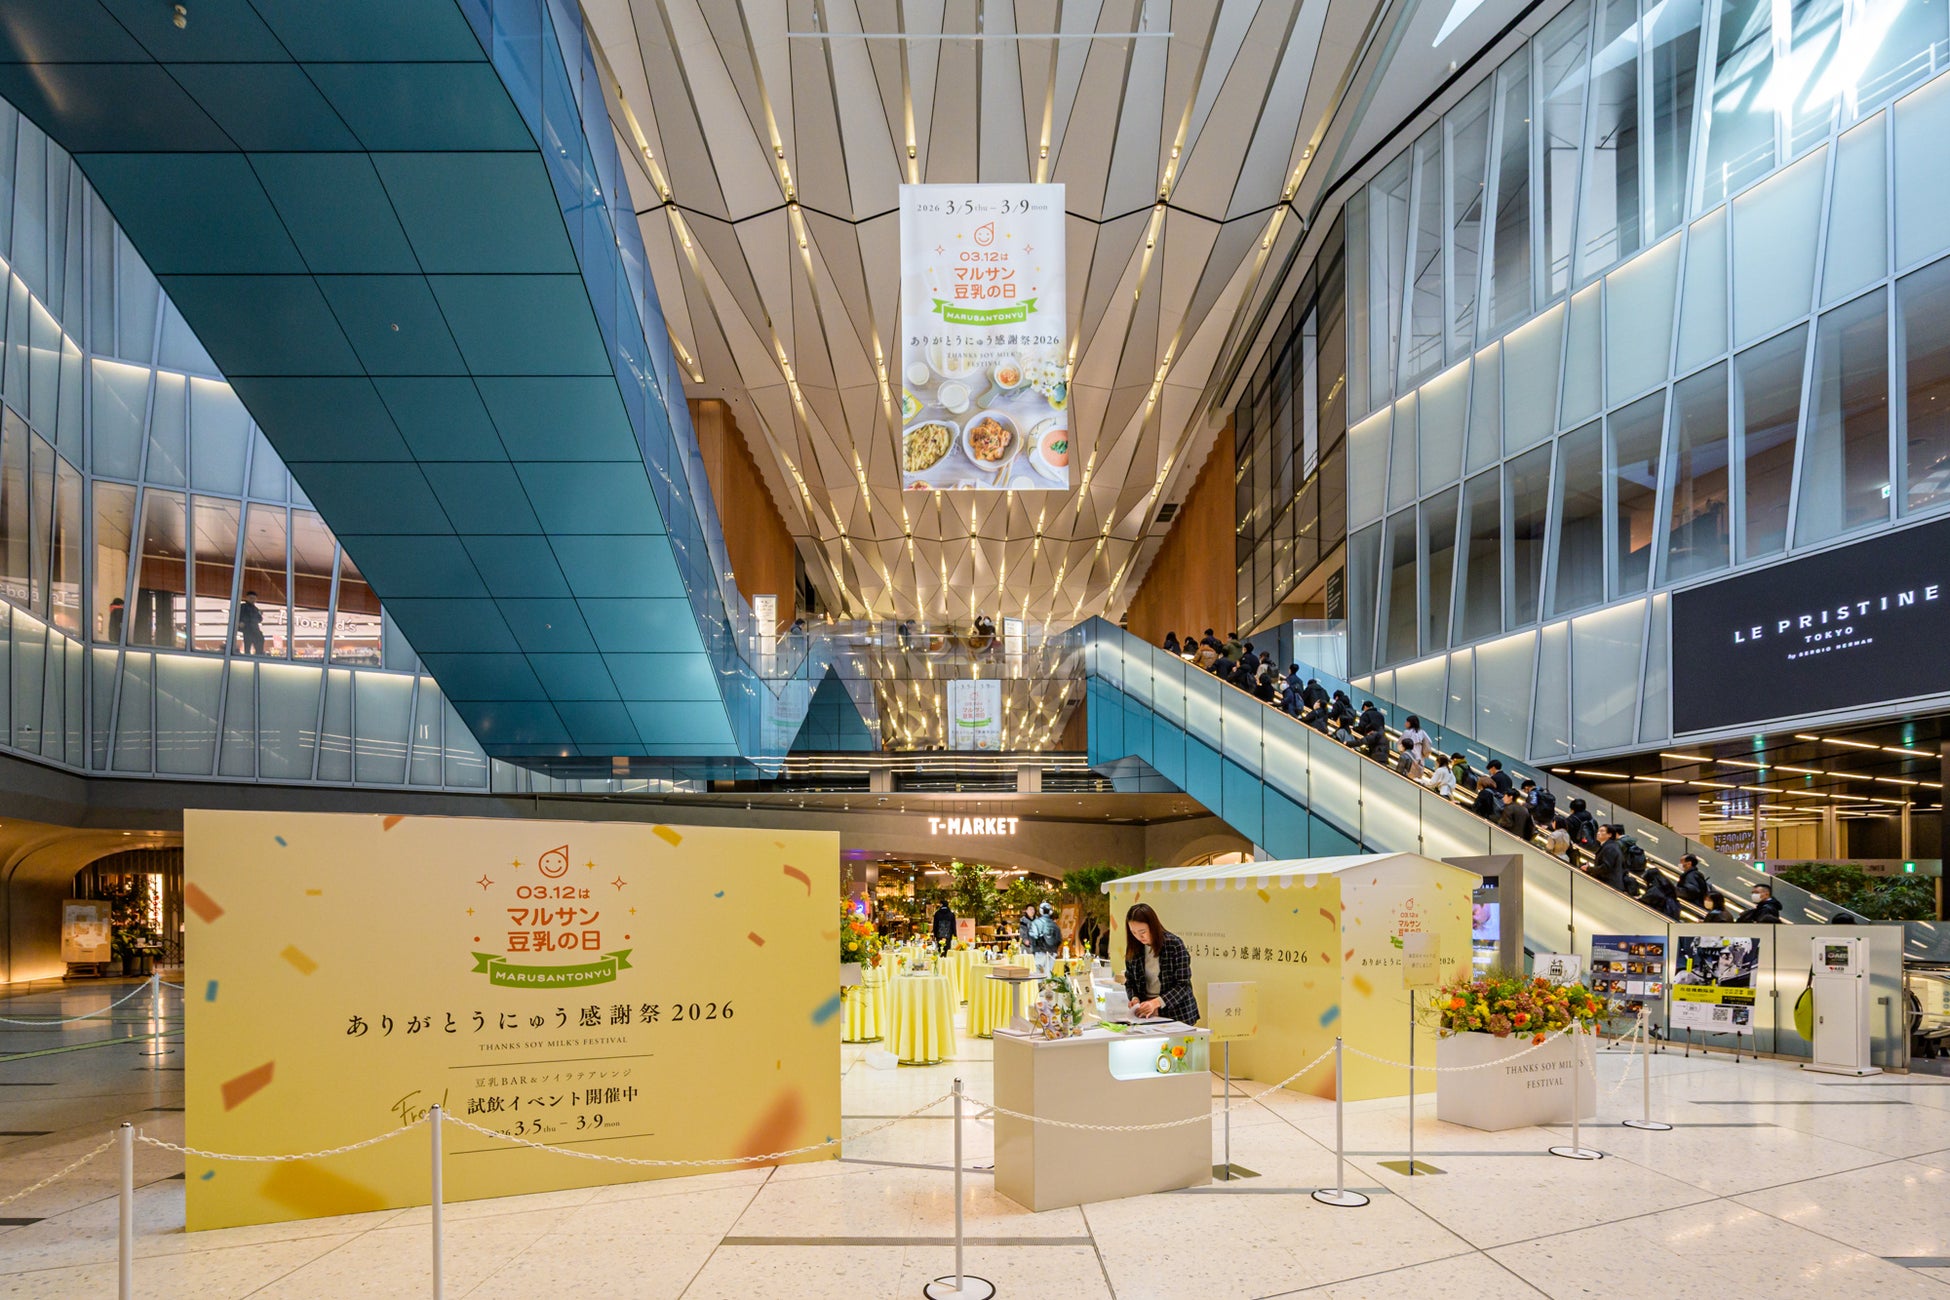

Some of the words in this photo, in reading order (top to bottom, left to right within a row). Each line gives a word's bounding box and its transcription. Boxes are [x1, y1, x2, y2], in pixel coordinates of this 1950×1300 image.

[917, 204, 940, 212] 2026
[959, 251, 1009, 262] 03.12は
[954, 267, 1016, 281] マルサン
[954, 283, 1016, 299] 豆乳の日
[946, 311, 1024, 322] MARUSANTONYU
[1734, 626, 1763, 644] LE
[1778, 585, 1939, 634] PRISTINE
[294, 615, 357, 633] Tomd's
[1805, 626, 1854, 643] TOKYO
[928, 817, 1019, 835] T-MARKET
[516, 885, 591, 900] 03.12は
[507, 907, 600, 926] マルサン
[507, 930, 601, 952] 豆乳の日
[1362, 958, 1402, 966] ありがとうに
[496, 968, 612, 982] MARUSANTONYU
[1224, 1008, 1242, 1016] 受付
[478, 1042, 521, 1051] THANKS
[524, 1040, 544, 1048] SOY
[548, 1038, 580, 1048] MILK'S
[583, 1036, 628, 1046] FESTIVAL
[1505, 1064, 1539, 1075] THANKS
[1541, 1062, 1556, 1071] SOY
[1526, 1078, 1564, 1089] FESTIVAL
[467, 1086, 638, 1114] 試飲イベント開催中
